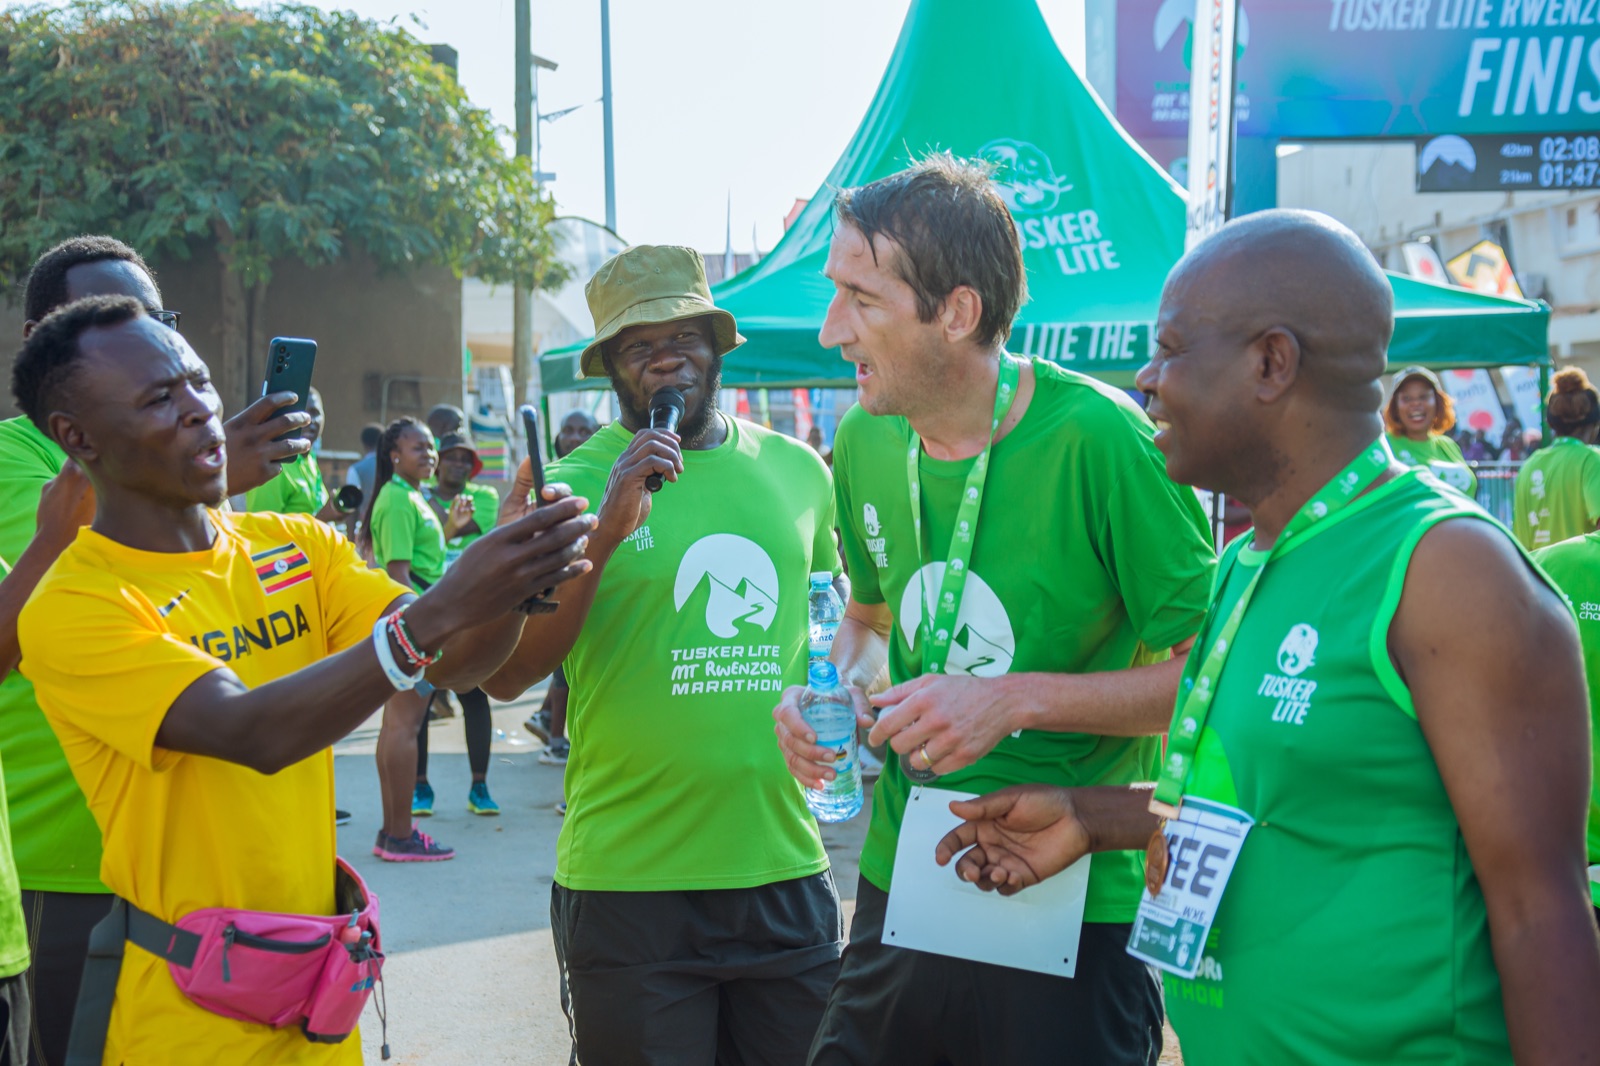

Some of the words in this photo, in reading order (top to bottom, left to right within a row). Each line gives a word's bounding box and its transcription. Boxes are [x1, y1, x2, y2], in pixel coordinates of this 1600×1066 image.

[1328, 0, 1431, 31] TUSKER
[1436, 0, 1493, 29] LITE
[1499, 0, 1600, 27] RWENZ
[1016, 209, 1102, 252] SKER
[1055, 240, 1120, 275] LITE
[1022, 322, 1078, 361] LITE
[1086, 320, 1137, 360] THE
[636, 536, 655, 552] LITE
[1579, 611, 1600, 621] cha
[1580, 601, 1600, 612] sta
[671, 646, 745, 662] TUSKER
[748, 645, 780, 657] LITE
[671, 664, 700, 681] MT
[671, 679, 783, 696] MARATHON
[1257, 673, 1318, 702] TUSKER
[1271, 699, 1311, 725] LITE
